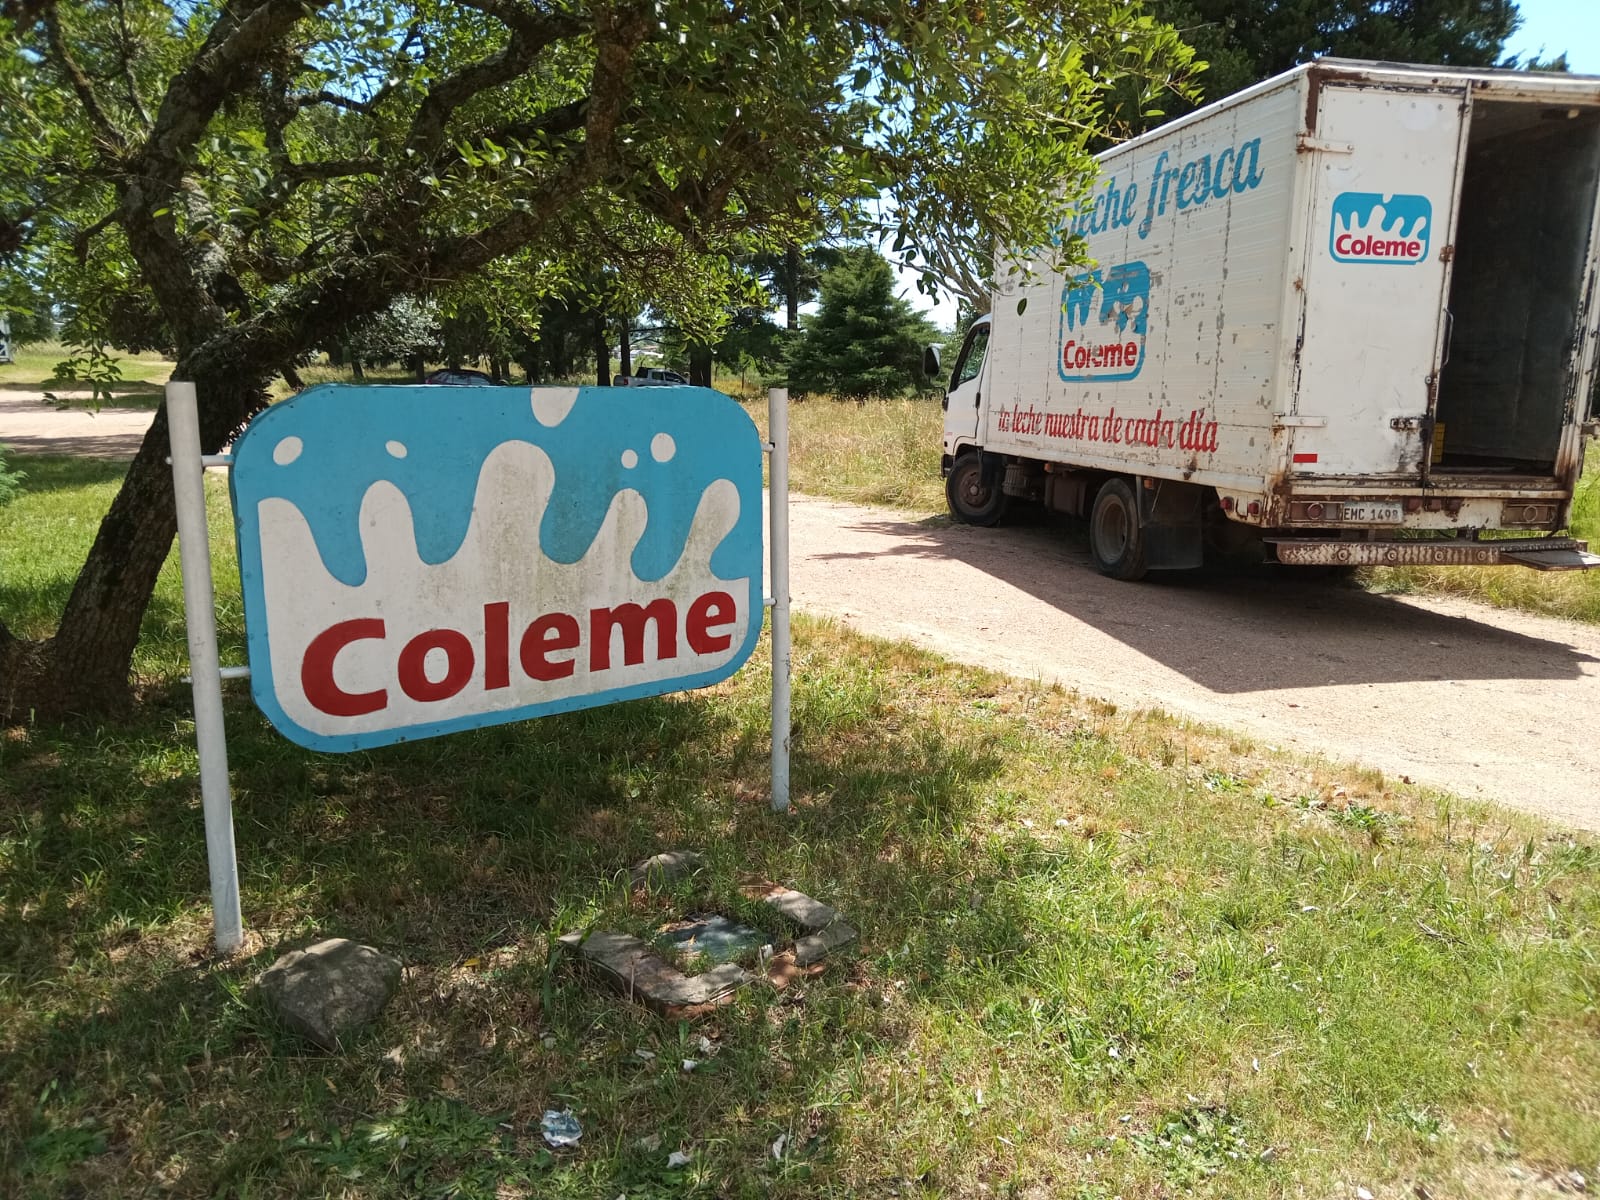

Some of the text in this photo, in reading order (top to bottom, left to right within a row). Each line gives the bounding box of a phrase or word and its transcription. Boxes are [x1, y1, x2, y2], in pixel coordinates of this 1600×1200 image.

[1138, 137, 1264, 240] fresca
[1336, 234, 1421, 257] Coleme
[1063, 340, 1137, 369] Coleme
[1012, 404, 1042, 435] leche
[1044, 407, 1100, 441] nuestra
[1102, 407, 1122, 443] de
[1125, 408, 1175, 449] cada
[1344, 507, 1365, 521] EMC
[301, 591, 737, 717] Coleme
